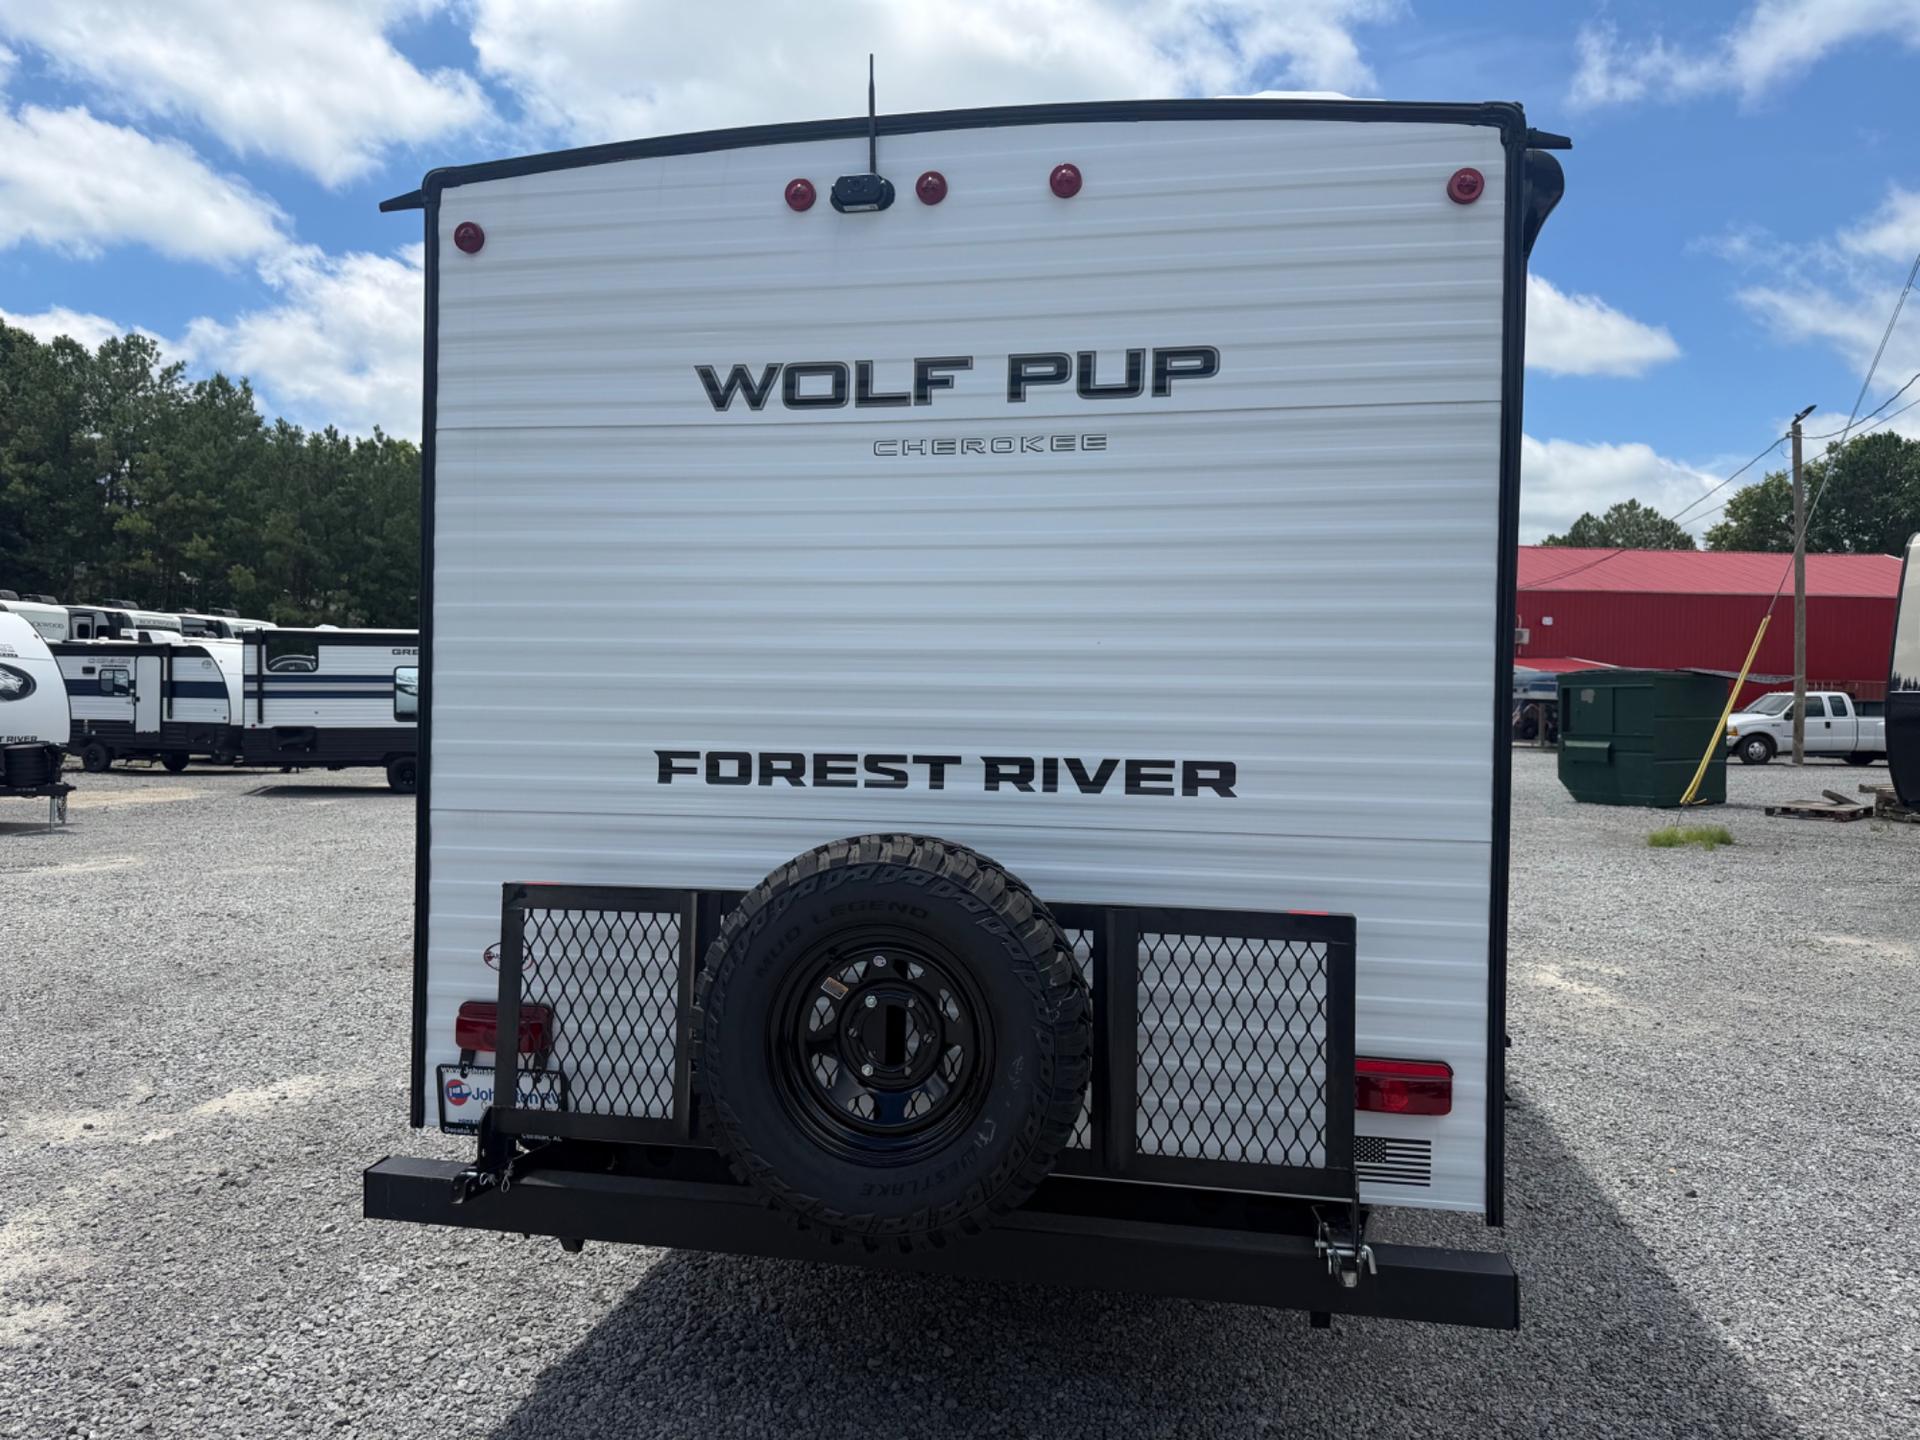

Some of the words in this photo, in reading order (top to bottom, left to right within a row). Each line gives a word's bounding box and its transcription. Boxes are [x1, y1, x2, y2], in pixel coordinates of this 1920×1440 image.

[693, 354, 974, 412] WOLF
[1007, 344, 1221, 404] PUP
[873, 433, 1108, 457] CHEROKEE
[391, 648, 419, 656] GRE
[6, 735, 38, 743] RIVER
[653, 749, 962, 790] FOREST
[979, 755, 1238, 798] RIVER
[754, 925, 801, 978] MUD
[811, 899, 930, 925] LEGEND
[857, 1145, 978, 1198] WESTLAKE
